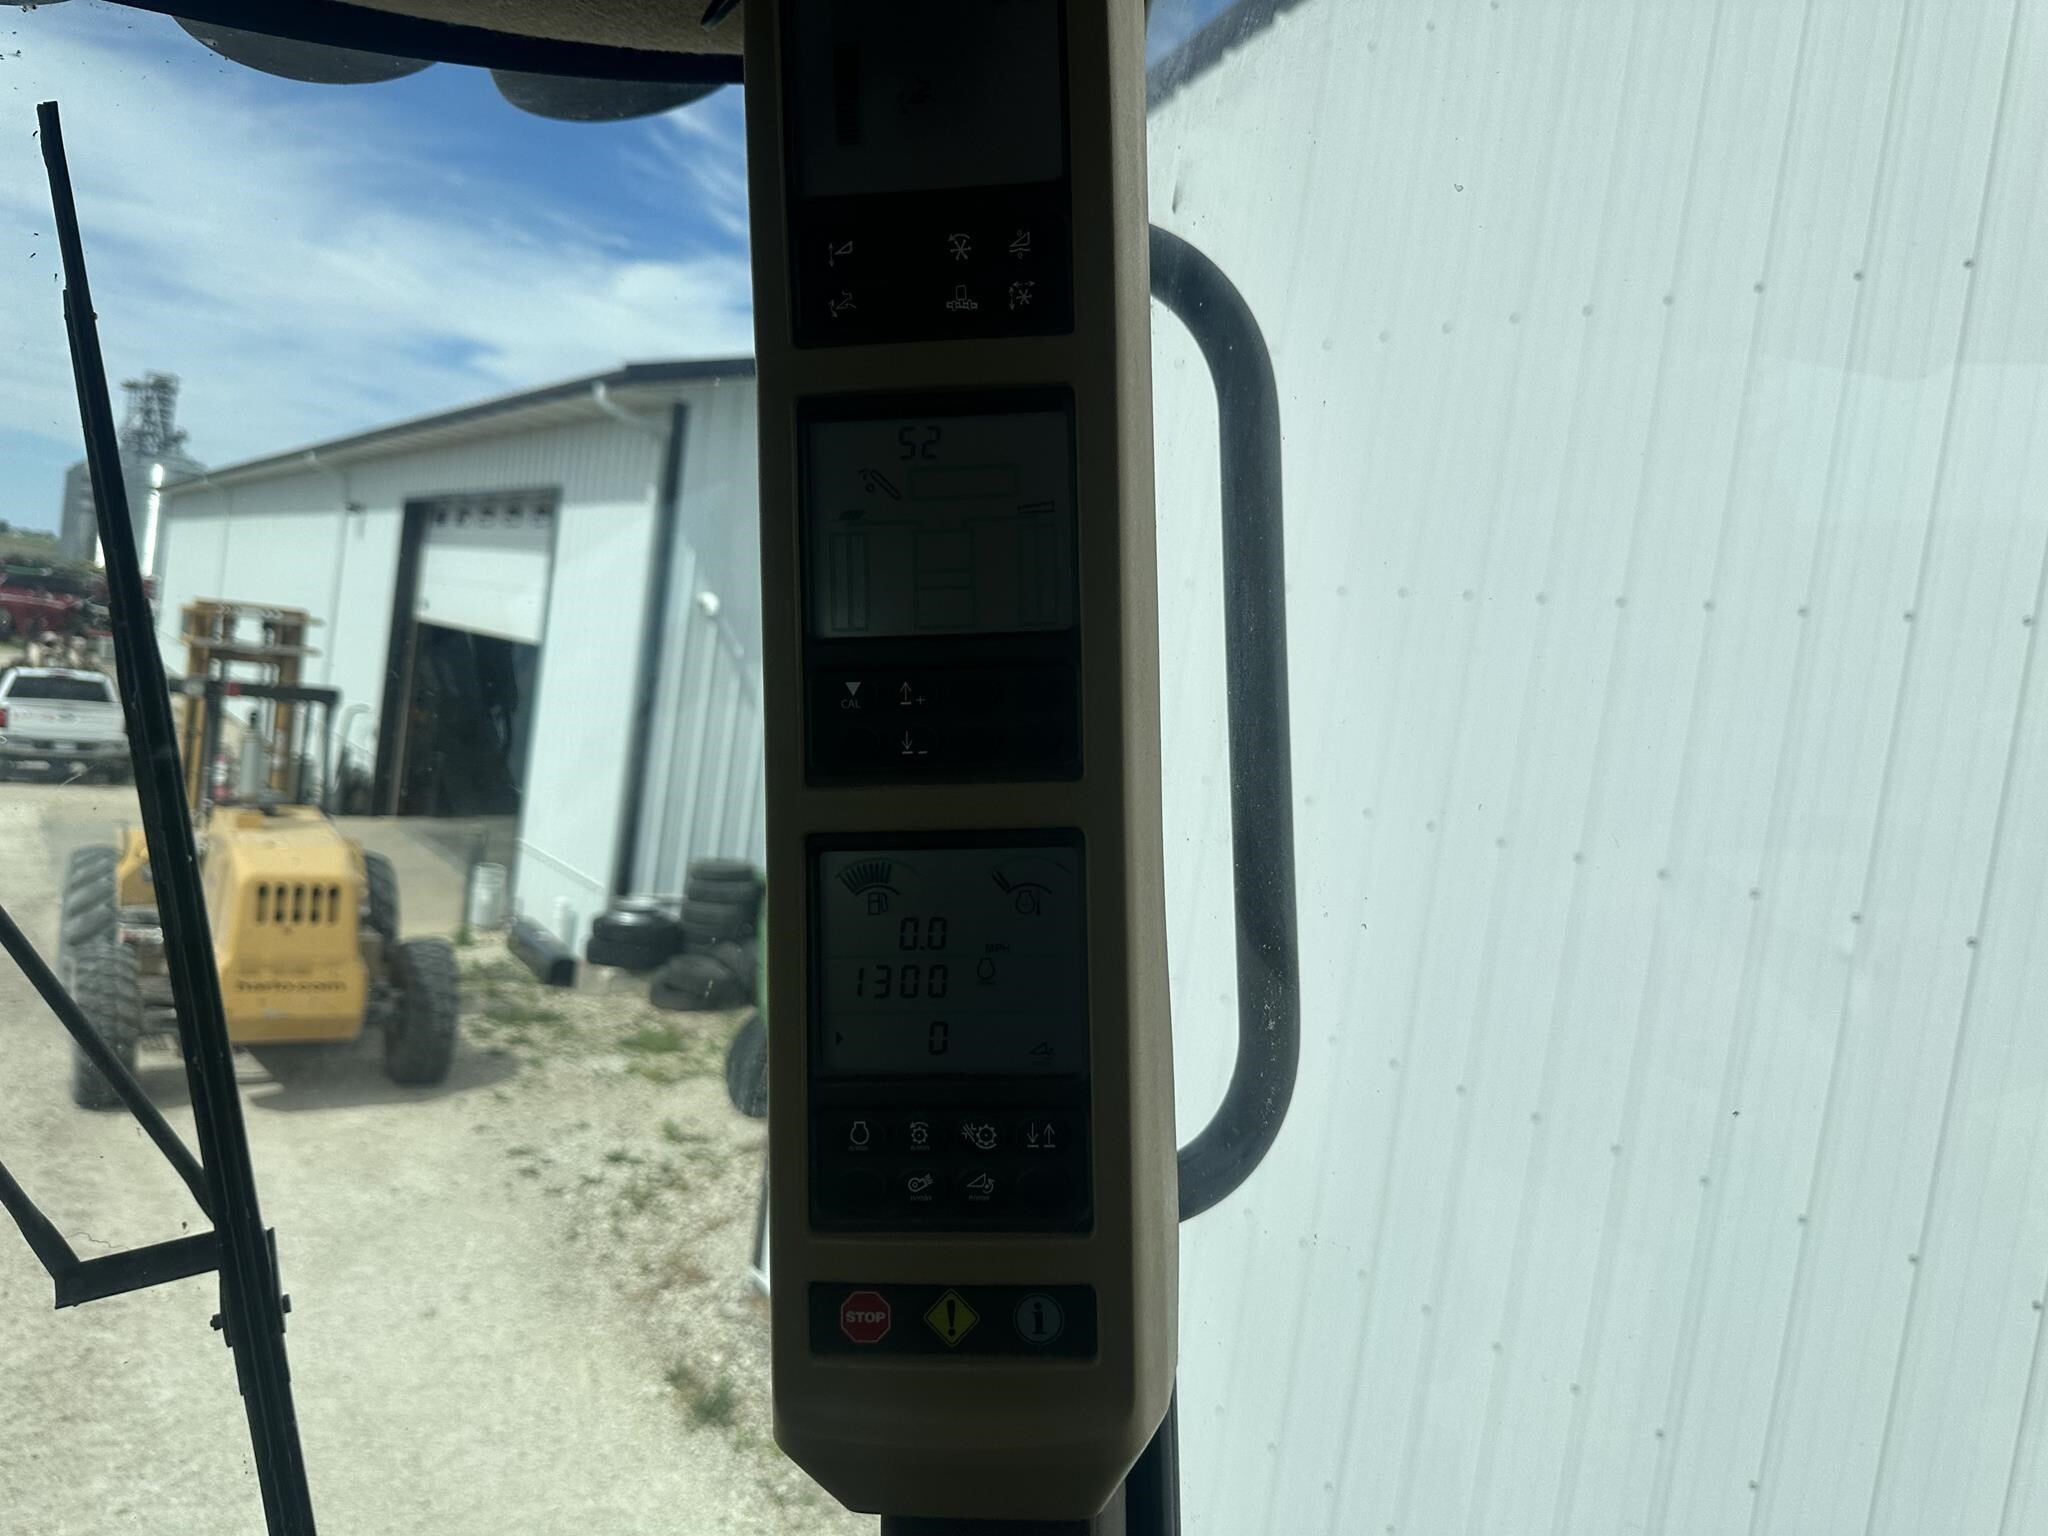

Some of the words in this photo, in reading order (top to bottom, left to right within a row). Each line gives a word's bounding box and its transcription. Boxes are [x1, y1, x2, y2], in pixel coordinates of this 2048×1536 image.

[898, 425, 942, 460] 52
[840, 698, 861, 710] CAL
[899, 917, 948, 951] 0.0
[857, 964, 948, 999] 1300
[928, 1020, 949, 1055] 0
[845, 1310, 887, 1324] STOP
